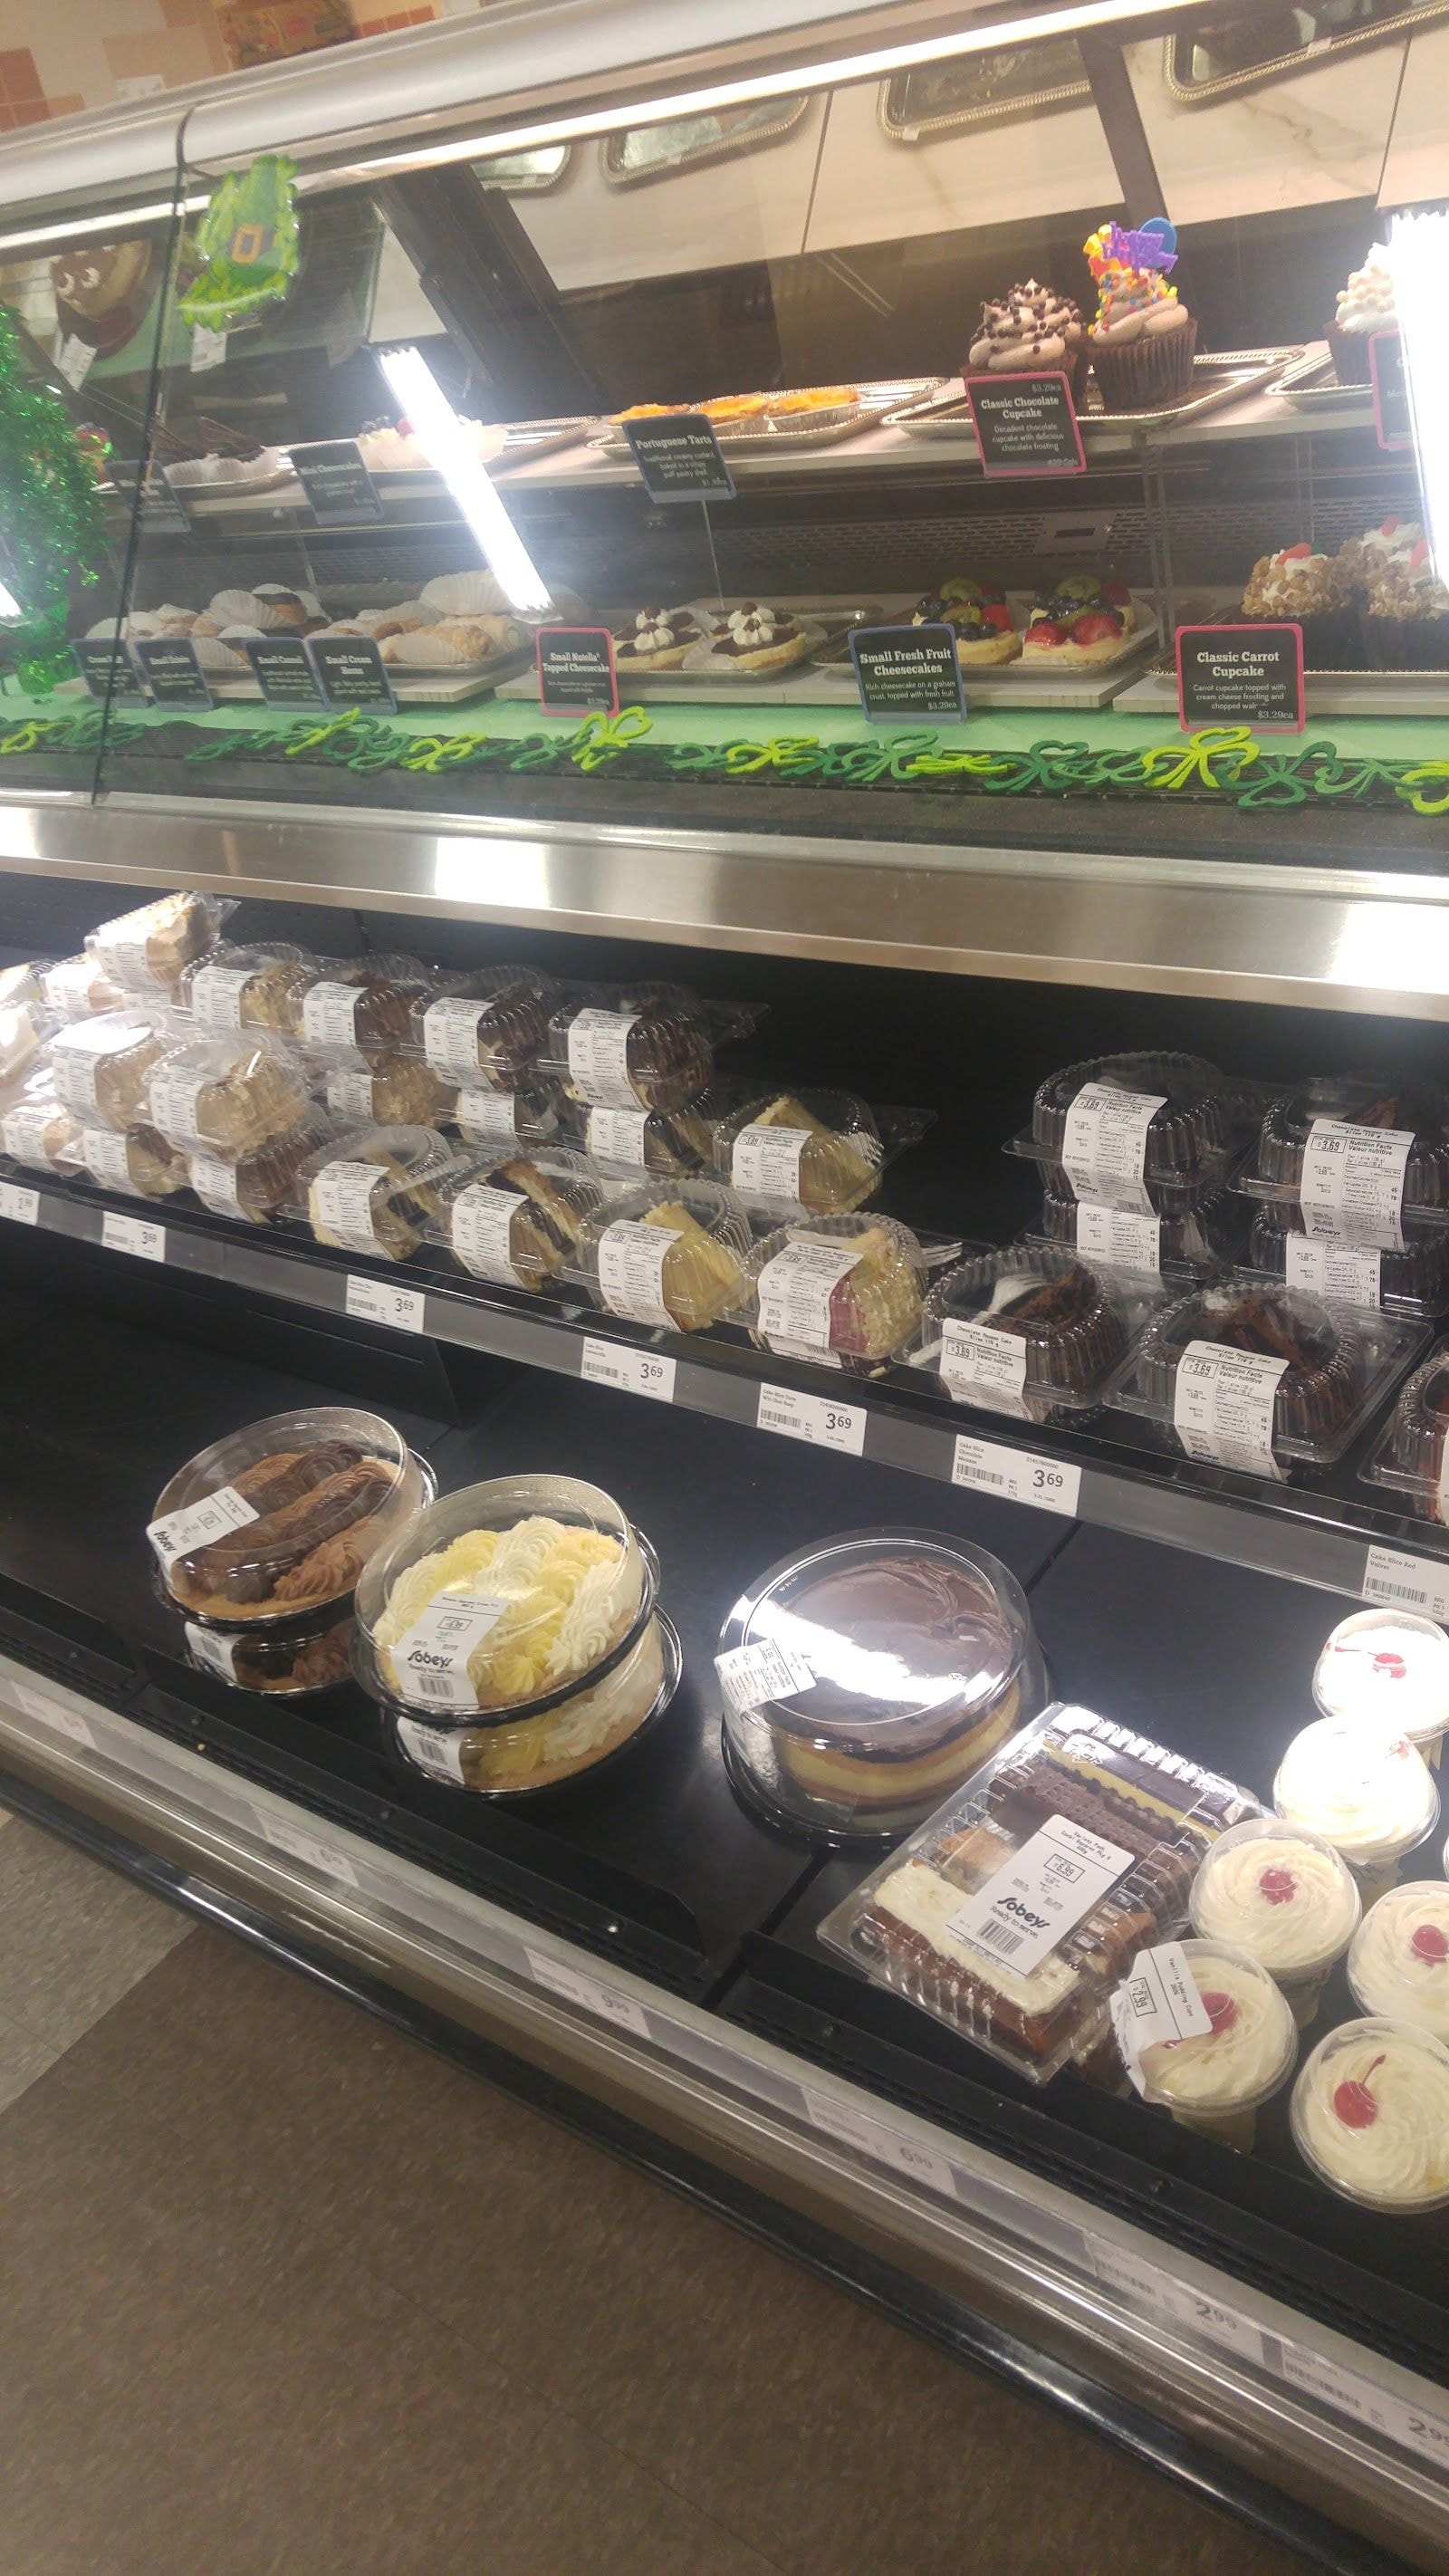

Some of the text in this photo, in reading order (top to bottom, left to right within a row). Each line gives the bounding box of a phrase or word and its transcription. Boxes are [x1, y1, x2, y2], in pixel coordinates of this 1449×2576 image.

[981, 396, 1060, 409] Classic Chocolate
[1003, 409, 1041, 420] Cupcake
[1026, 423, 1058, 431] chocolate
[636, 435, 712, 449] Portuguese Tarts
[993, 434, 1018, 443] cupcake
[1034, 443, 1059, 451] frosting
[551, 652, 571, 661] Small
[860, 648, 952, 664] Small Fresh Fruit
[1196, 651, 1280, 662] Classic Carrot
[542, 662, 609, 674] Topped Cheesecake
[874, 663, 942, 676] Cheesecakes
[1212, 666, 1264, 678] Cupcake
[881, 681, 916, 689] cheesecake
[934, 681, 955, 689] graham
[1215, 684, 1243, 692] cupcake
[1245, 684, 1269, 692] topped
[888, 692, 908, 700] topped
[1243, 693, 1269, 702] frosting
[1258, 710, 1293, 719] $3.29ea
[1312, 1226, 1340, 1235] Sobeys
[977, 1348, 996, 1356] Nutrition
[640, 1363, 663, 1379] 369
[1221, 1365, 1262, 1378] Nutrition Facts
[1219, 1370, 1262, 1384] Valeur nutritive
[826, 1413, 851, 1429] 369
[959, 1449, 983, 1459] Chocolate
[958, 1456, 976, 1465] Mousse
[1033, 1469, 1063, 1487] 369
[1370, 1561, 1389, 1570] Velvet
[408, 1650, 454, 1668] Sobeys
[990, 1905, 1012, 1921] Ready
[997, 1897, 1051, 1928] Sobeys
[1169, 1958, 1179, 1980] Vanilla
[1178, 1982, 1188, 2004] Pudding
[1195, 2300, 1237, 2331] 299
